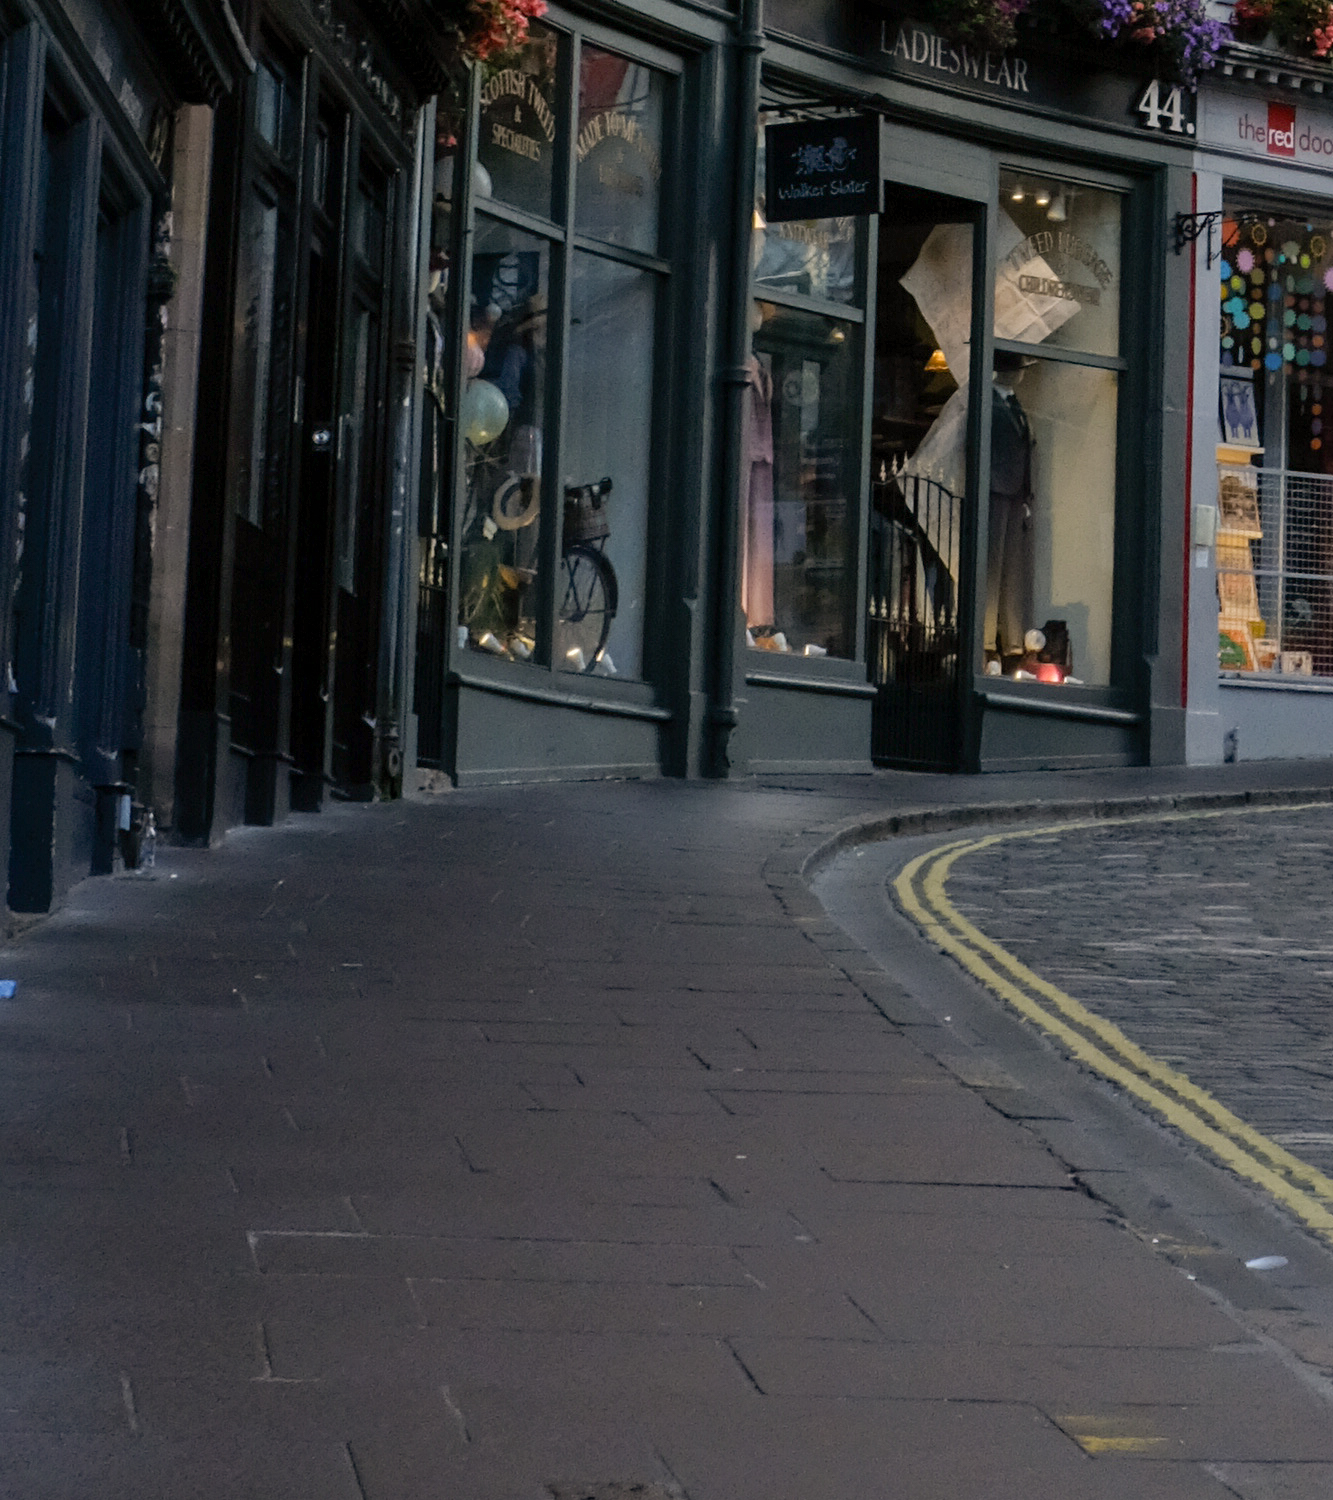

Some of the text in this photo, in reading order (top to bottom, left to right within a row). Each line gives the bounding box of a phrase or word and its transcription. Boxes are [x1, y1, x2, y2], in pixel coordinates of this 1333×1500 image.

[880, 19, 1030, 93] LADIESWEAR
[1238, 113, 1266, 145] the
[1267, 120, 1295, 150] red
